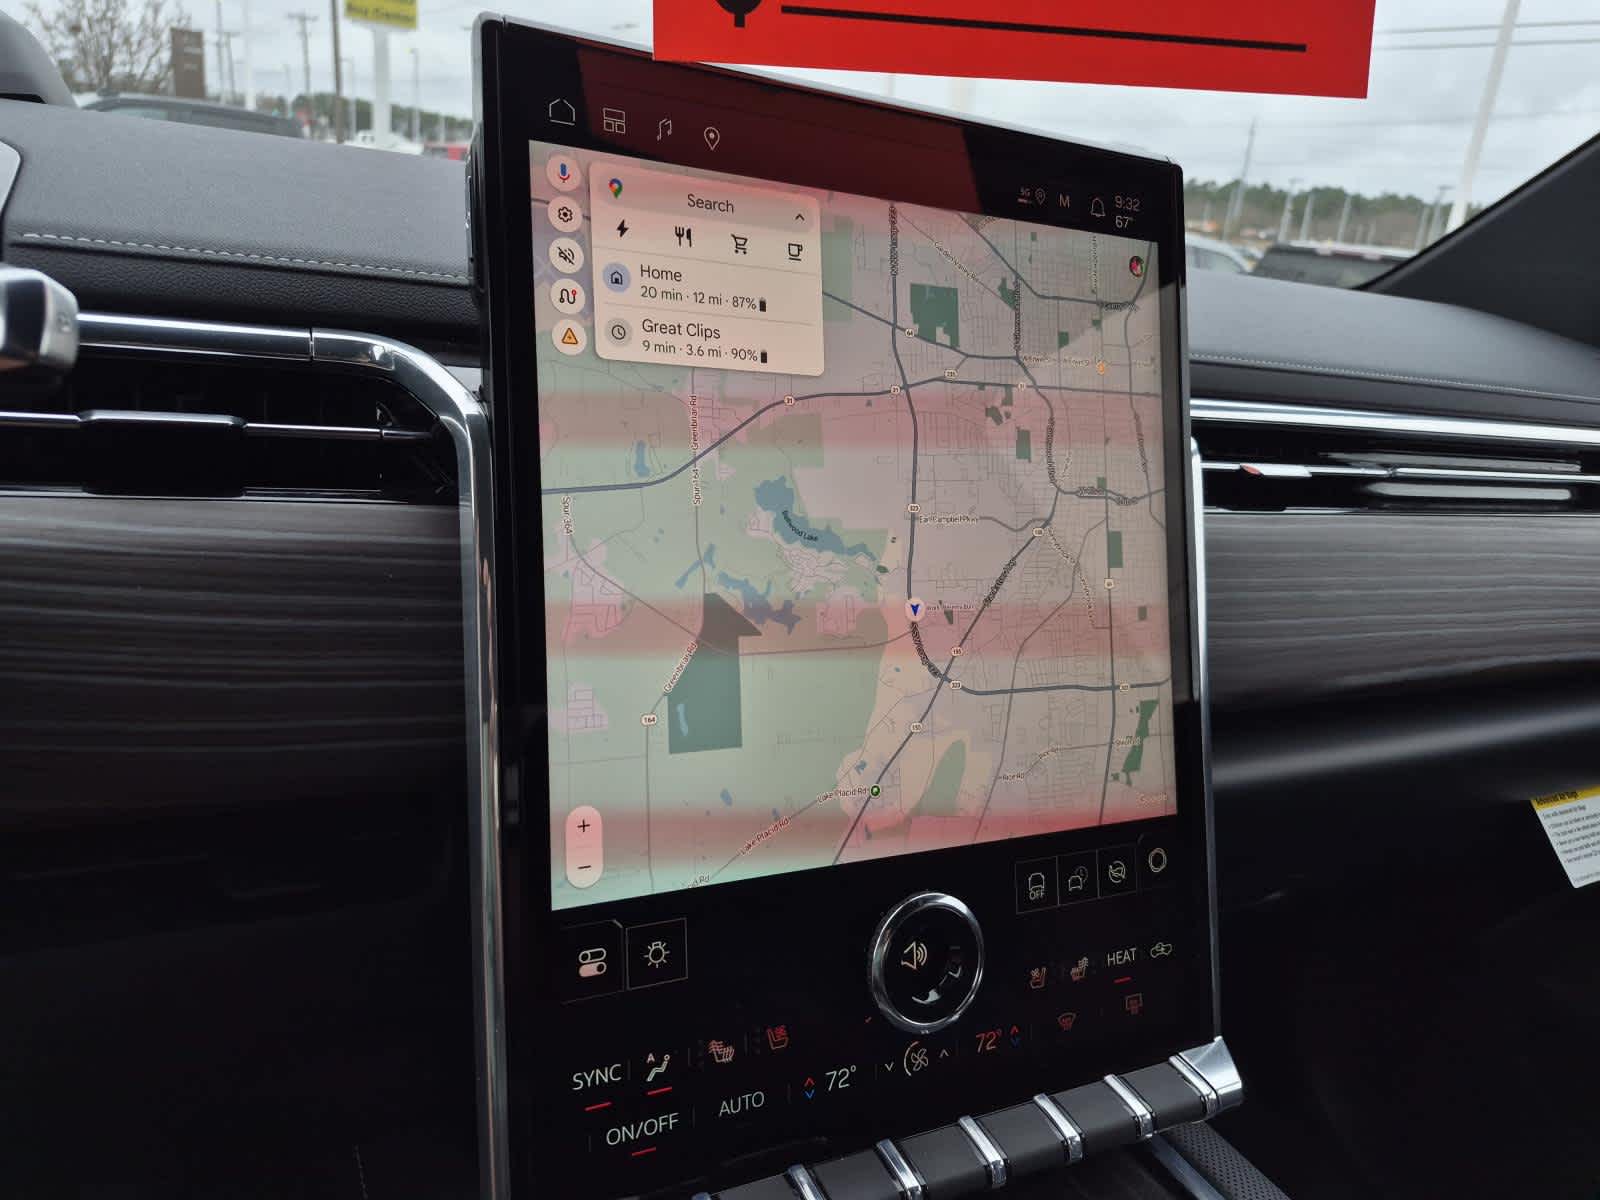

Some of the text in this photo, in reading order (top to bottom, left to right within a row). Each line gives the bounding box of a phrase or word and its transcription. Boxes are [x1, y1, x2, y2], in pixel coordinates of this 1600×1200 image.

[687, 193, 735, 213] Search
[1059, 193, 1070, 208] M
[1114, 195, 1140, 212] 9:32
[640, 264, 682, 282] Home
[640, 286, 757, 311] 20 min 12 mi 87%
[642, 318, 721, 340] Great Clips
[642, 340, 758, 362] 9 min 3.6 mi 90%
[690, 407, 698, 450] Greenbriar
[562, 496, 574, 535] Spur 364
[663, 642, 698, 693] Greenbriar Rd
[1029, 889, 1045, 901] OFF
[1107, 947, 1137, 966] HEAT
[976, 1028, 1002, 1053] 72°
[646, 1053, 656, 1064] A
[572, 1063, 622, 1091] SYNC
[825, 1065, 857, 1091] 72°
[718, 1091, 765, 1117] AUTO
[606, 1113, 679, 1145] ON/OFF
